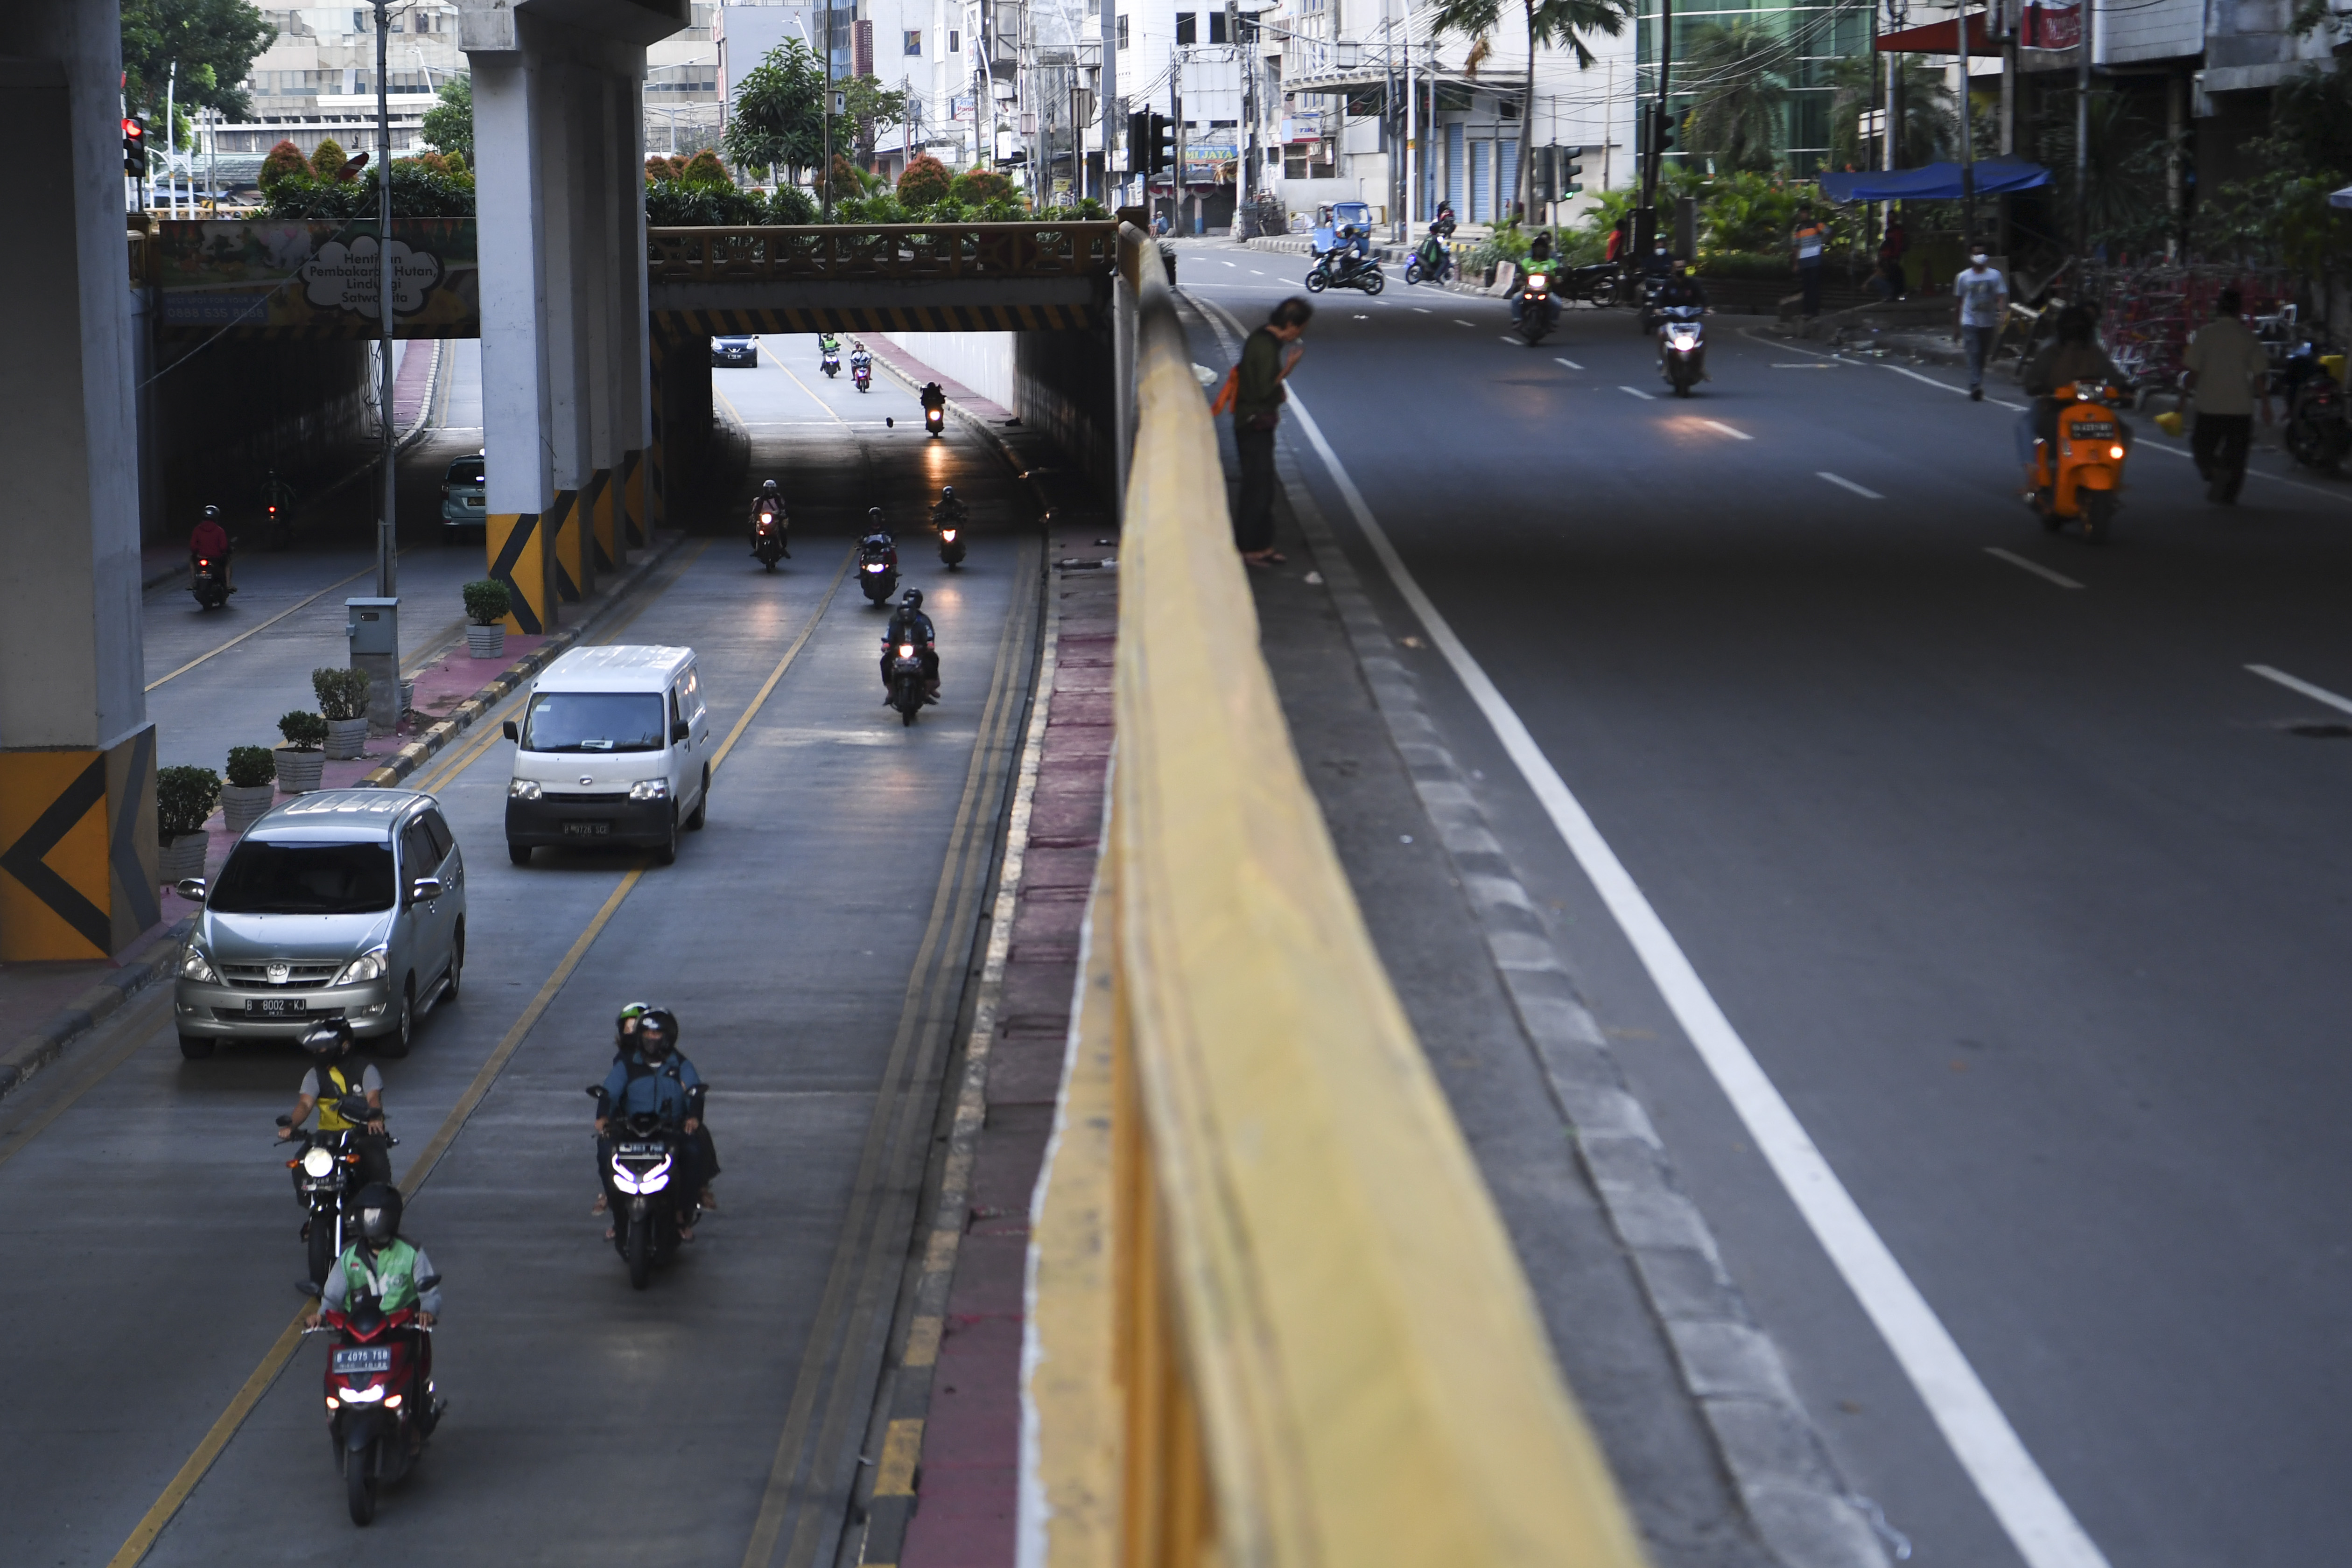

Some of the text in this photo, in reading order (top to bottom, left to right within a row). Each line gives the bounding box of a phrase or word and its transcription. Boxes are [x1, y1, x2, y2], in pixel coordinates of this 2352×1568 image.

[1202, 150, 1234, 159] JAYA
[344, 253, 401, 264] Hentin
[309, 266, 437, 278] Pembakara Hutan,
[347, 279, 401, 291] Lindugi
[168, 308, 200, 318] 0888
[204, 308, 228, 318] 535
[246, 1000, 305, 1011] B 8002 KJ
